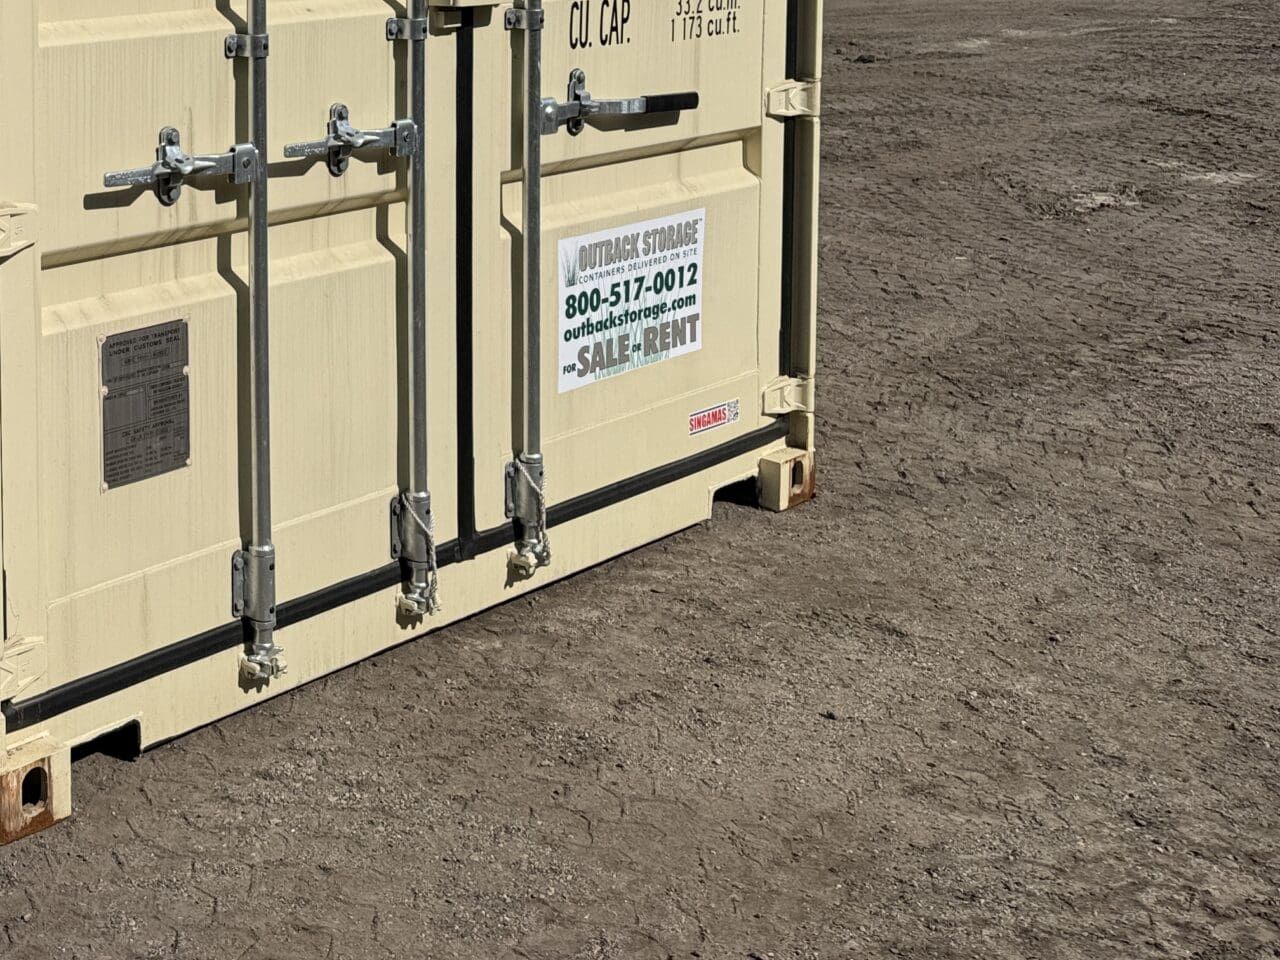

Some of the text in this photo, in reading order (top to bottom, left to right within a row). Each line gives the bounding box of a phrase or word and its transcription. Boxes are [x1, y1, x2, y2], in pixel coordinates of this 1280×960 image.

[569, 0, 592, 50] CU.
[682, 15, 702, 41] 173
[579, 232, 640, 272] OUTBACK
[579, 247, 698, 284] CONTAINERS DELIVERED ON SITE
[565, 262, 698, 319] 800-517-0012
[564, 293, 696, 342] outbackstorage.com
[563, 313, 700, 378] FOR SALE OR RENT
[689, 407, 727, 432] SINGAMAS
